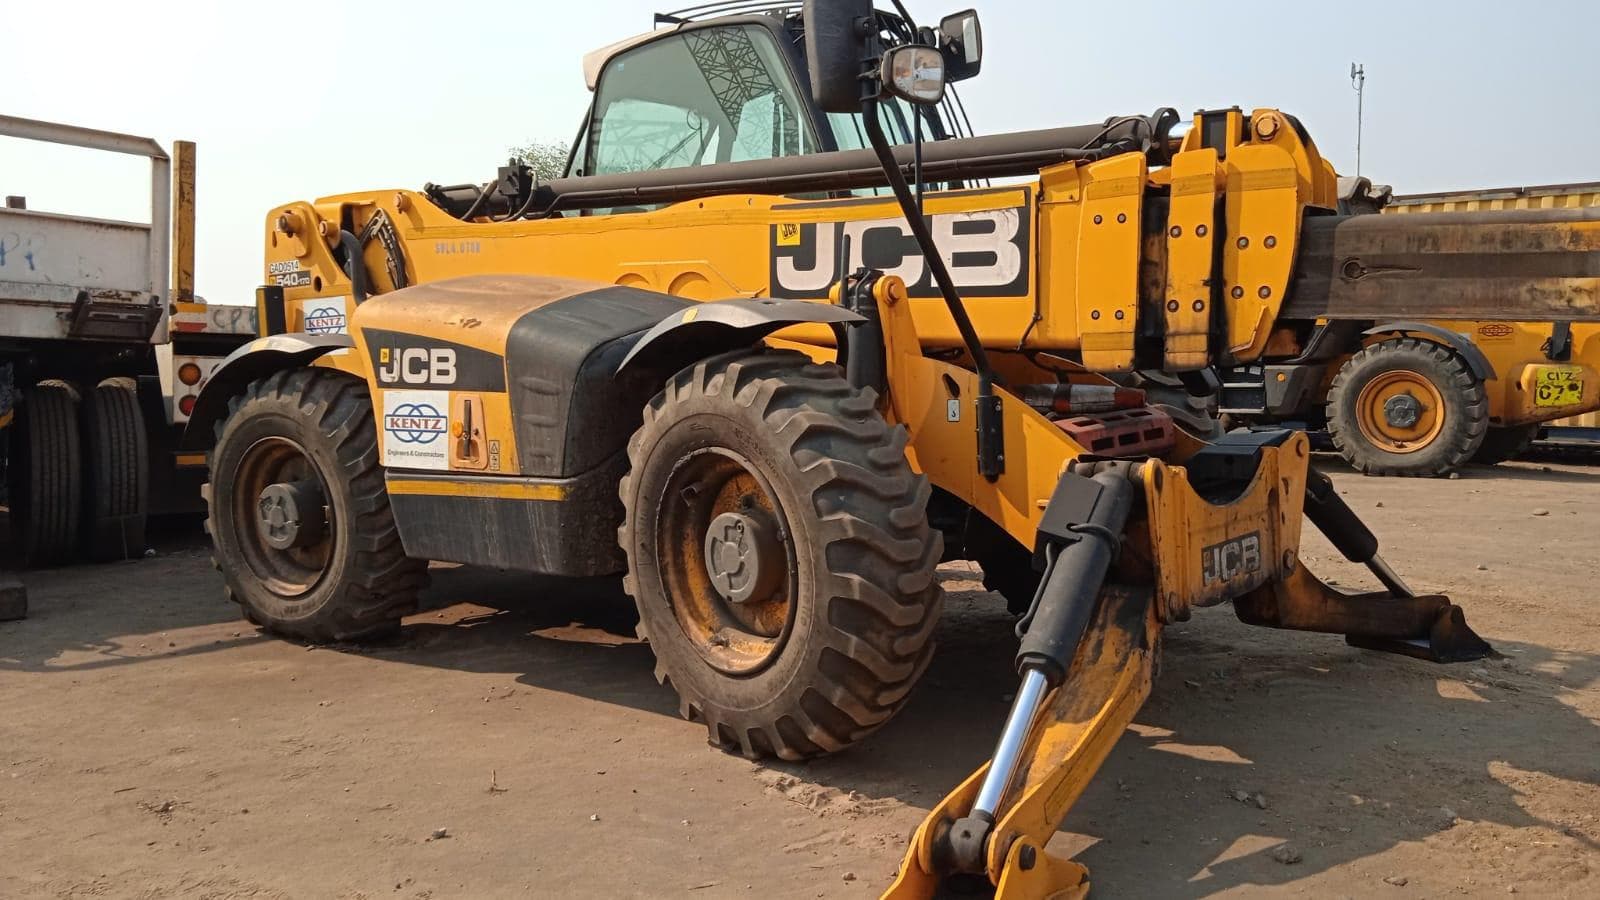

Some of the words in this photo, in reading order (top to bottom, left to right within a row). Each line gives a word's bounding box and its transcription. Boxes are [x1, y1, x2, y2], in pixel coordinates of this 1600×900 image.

[776, 206, 1021, 291] JCB
[308, 318, 342, 328] KENTZ
[380, 347, 457, 384] JCB
[390, 417, 443, 430] KENTZ
[1204, 536, 1260, 587] JCB
